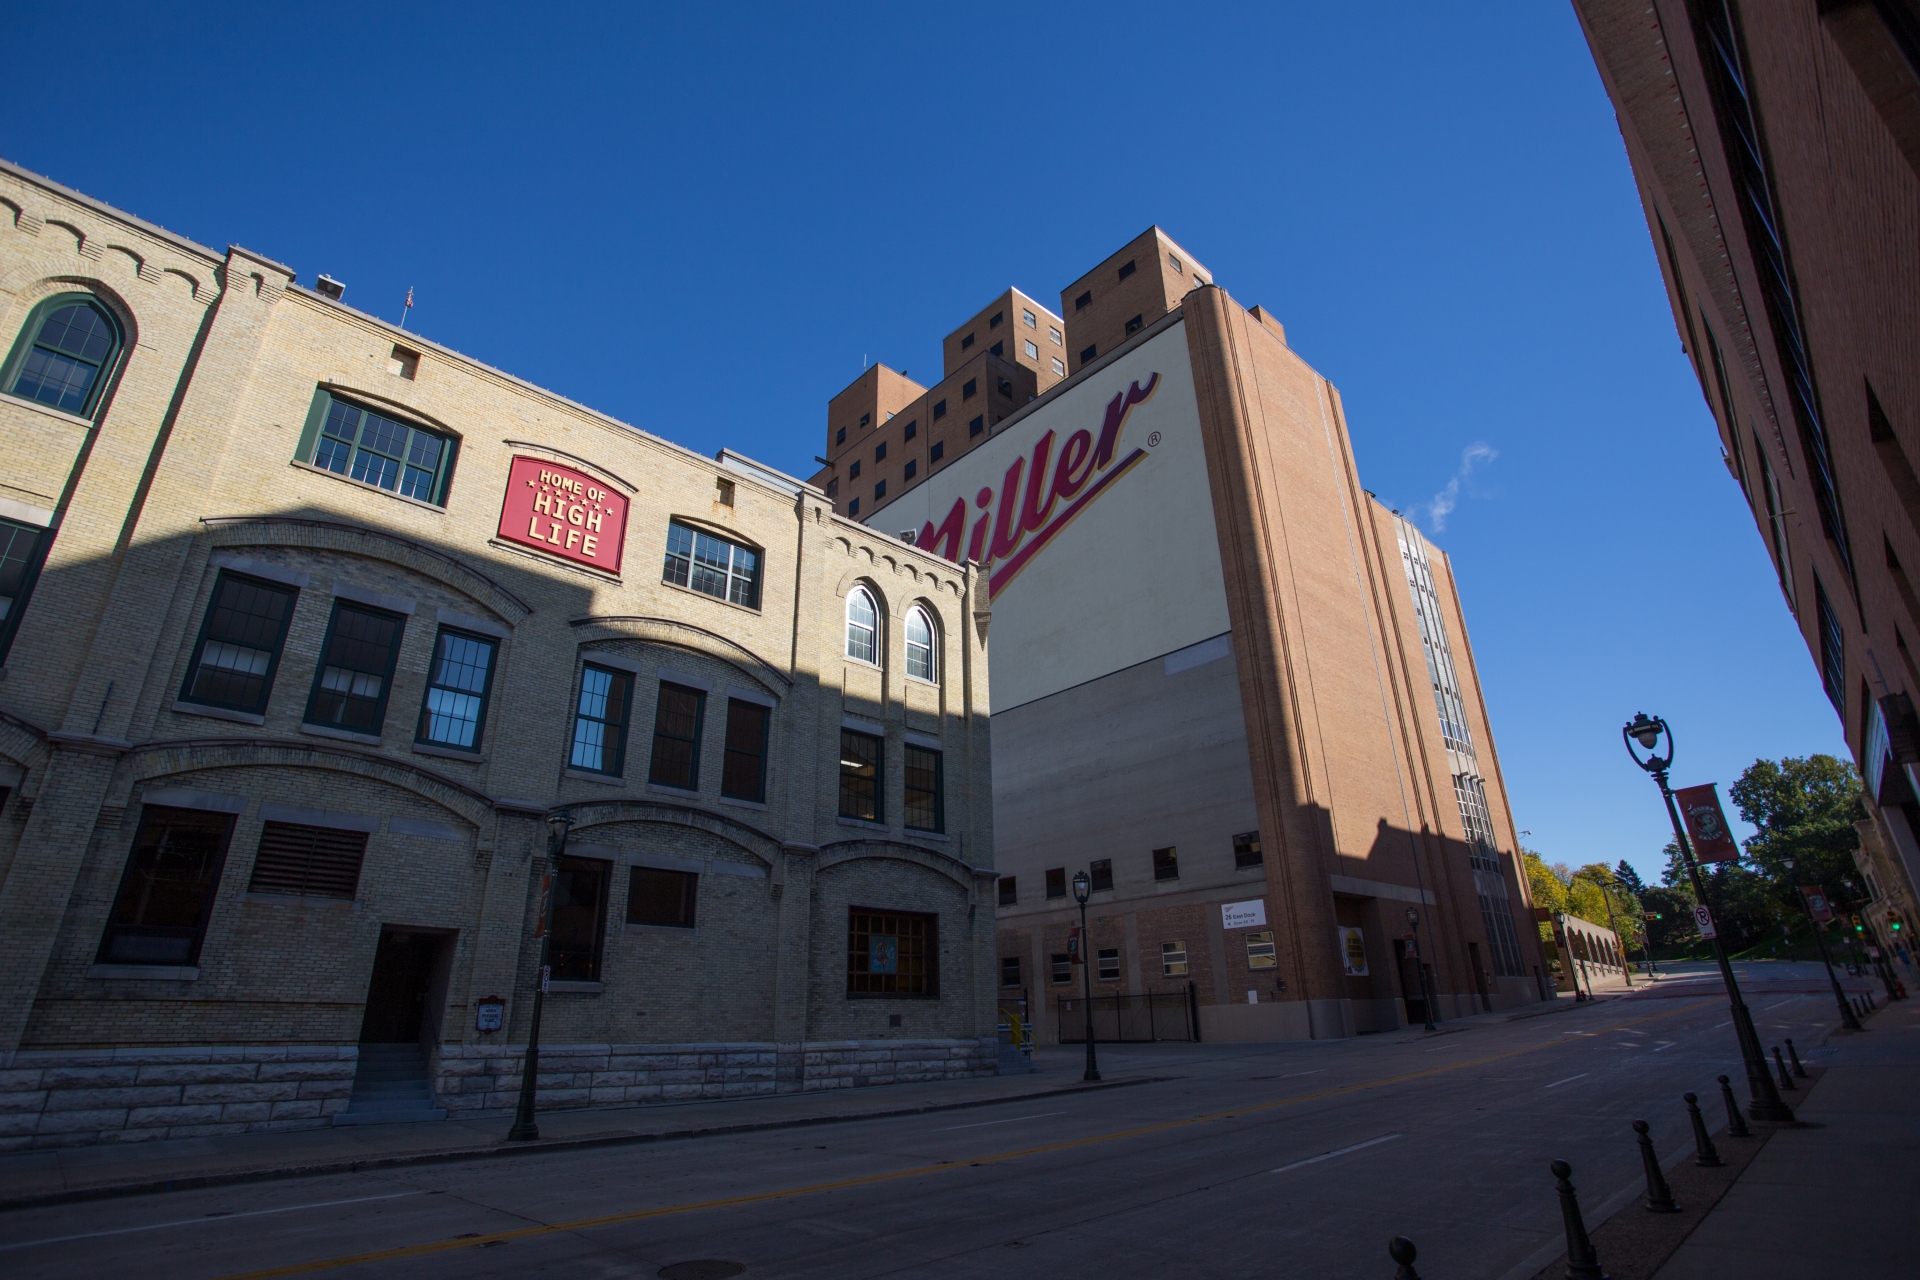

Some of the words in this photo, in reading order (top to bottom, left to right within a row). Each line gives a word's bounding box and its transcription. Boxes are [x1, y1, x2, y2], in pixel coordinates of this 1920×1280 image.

[539, 469, 583, 495] HOME
[586, 487, 606, 503] OF
[533, 492, 603, 534] HIGH
[527, 516, 598, 557] LIFE
